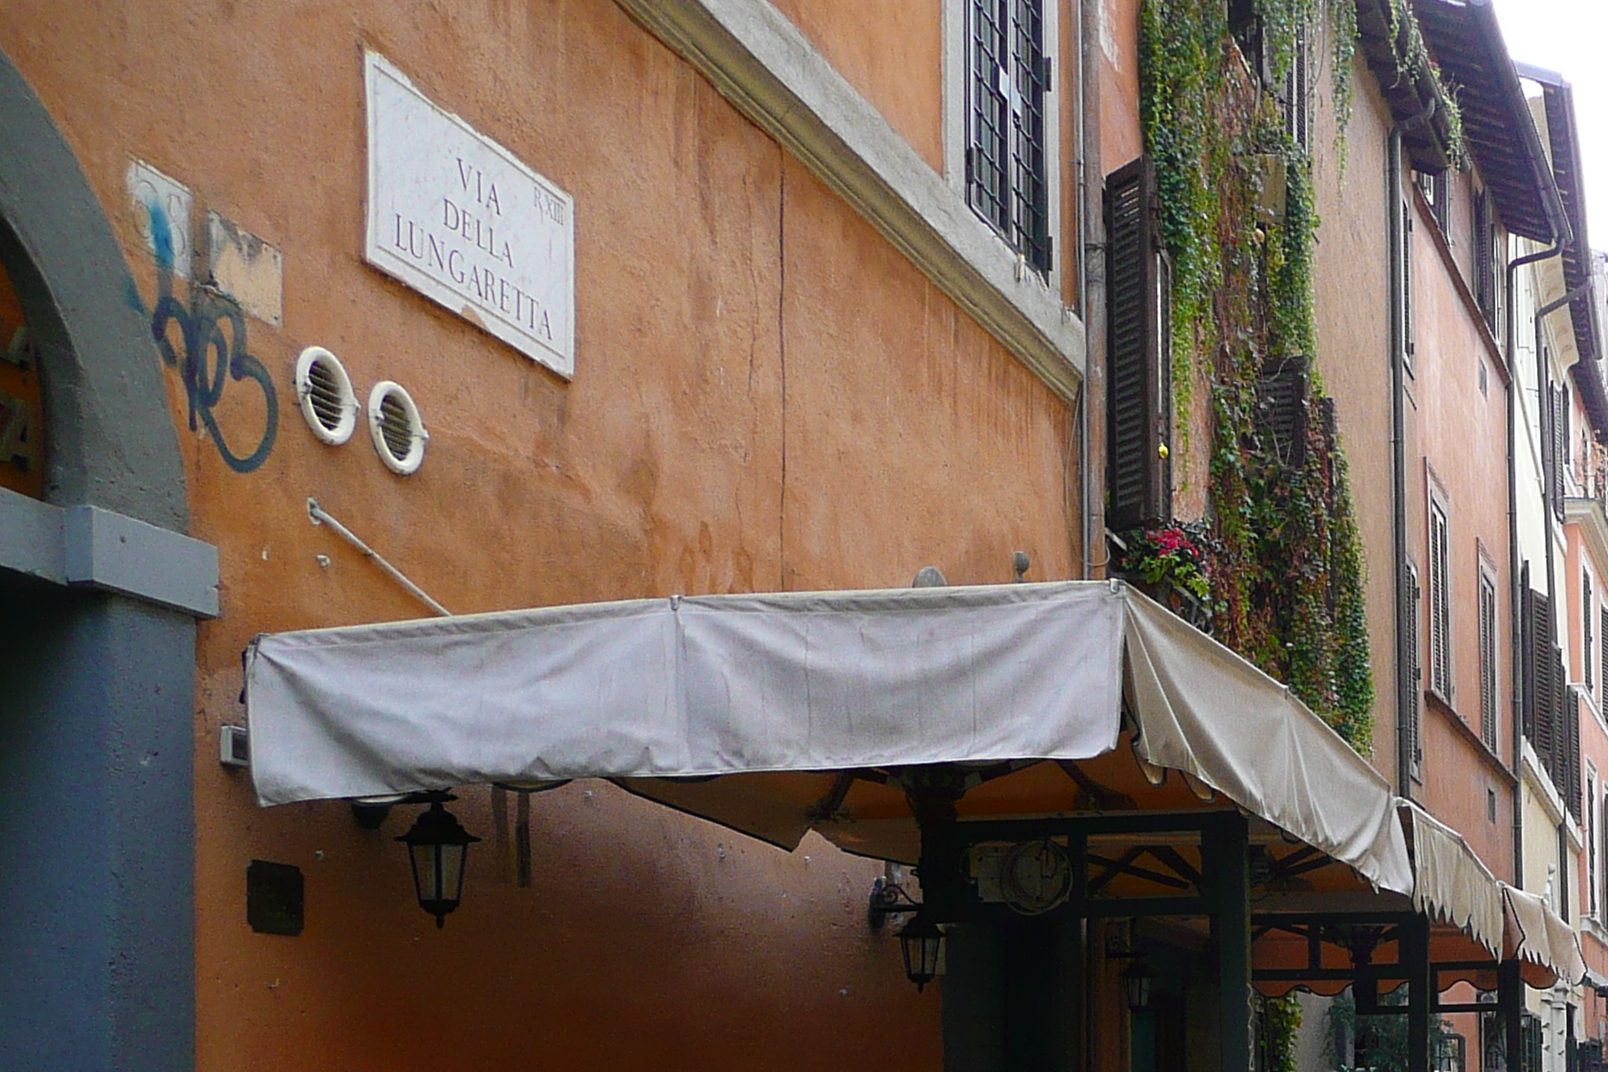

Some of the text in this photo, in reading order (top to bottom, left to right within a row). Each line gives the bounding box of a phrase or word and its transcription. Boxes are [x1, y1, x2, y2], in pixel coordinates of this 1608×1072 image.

[456, 157, 501, 217] VIA
[443, 197, 514, 269] DELLA
[395, 212, 553, 341] LUNGARETTA
